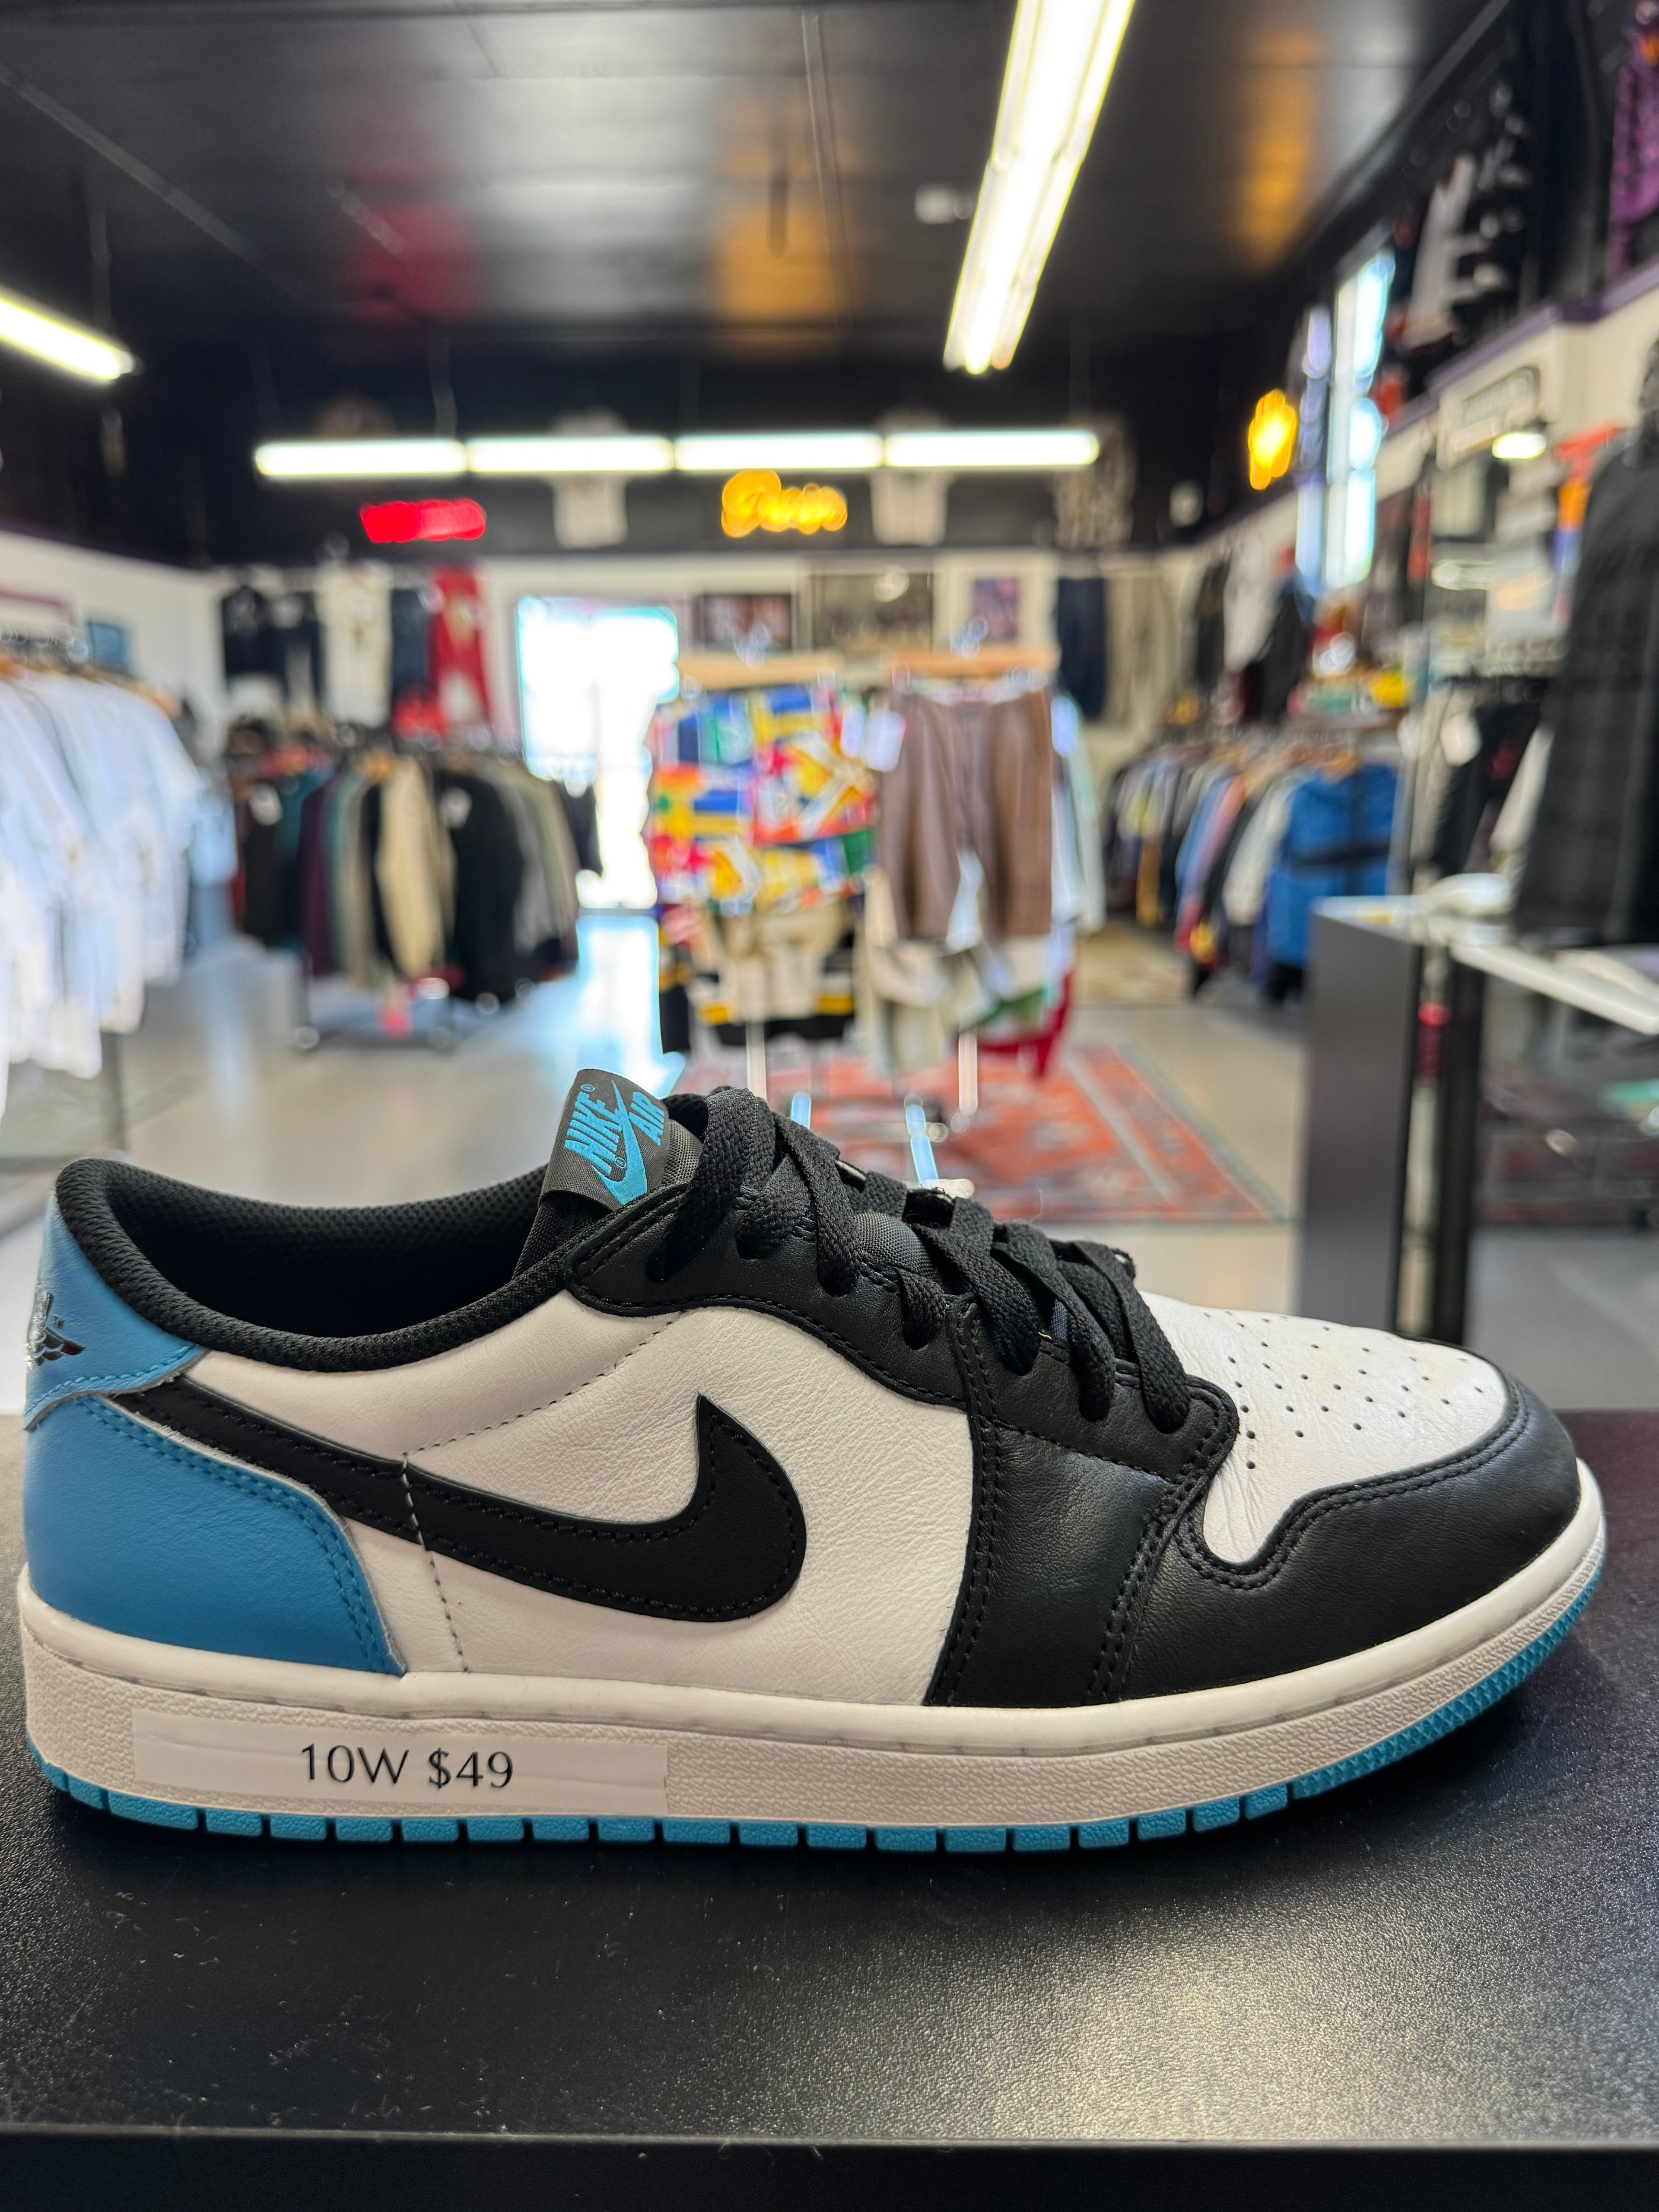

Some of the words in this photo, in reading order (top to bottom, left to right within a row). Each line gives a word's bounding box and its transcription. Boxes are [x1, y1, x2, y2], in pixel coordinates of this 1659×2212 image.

[564, 1092, 623, 1174] NIKE
[629, 1092, 664, 1146] AIR
[302, 1743, 409, 1784] 10W
[429, 1747, 513, 1789] $49
